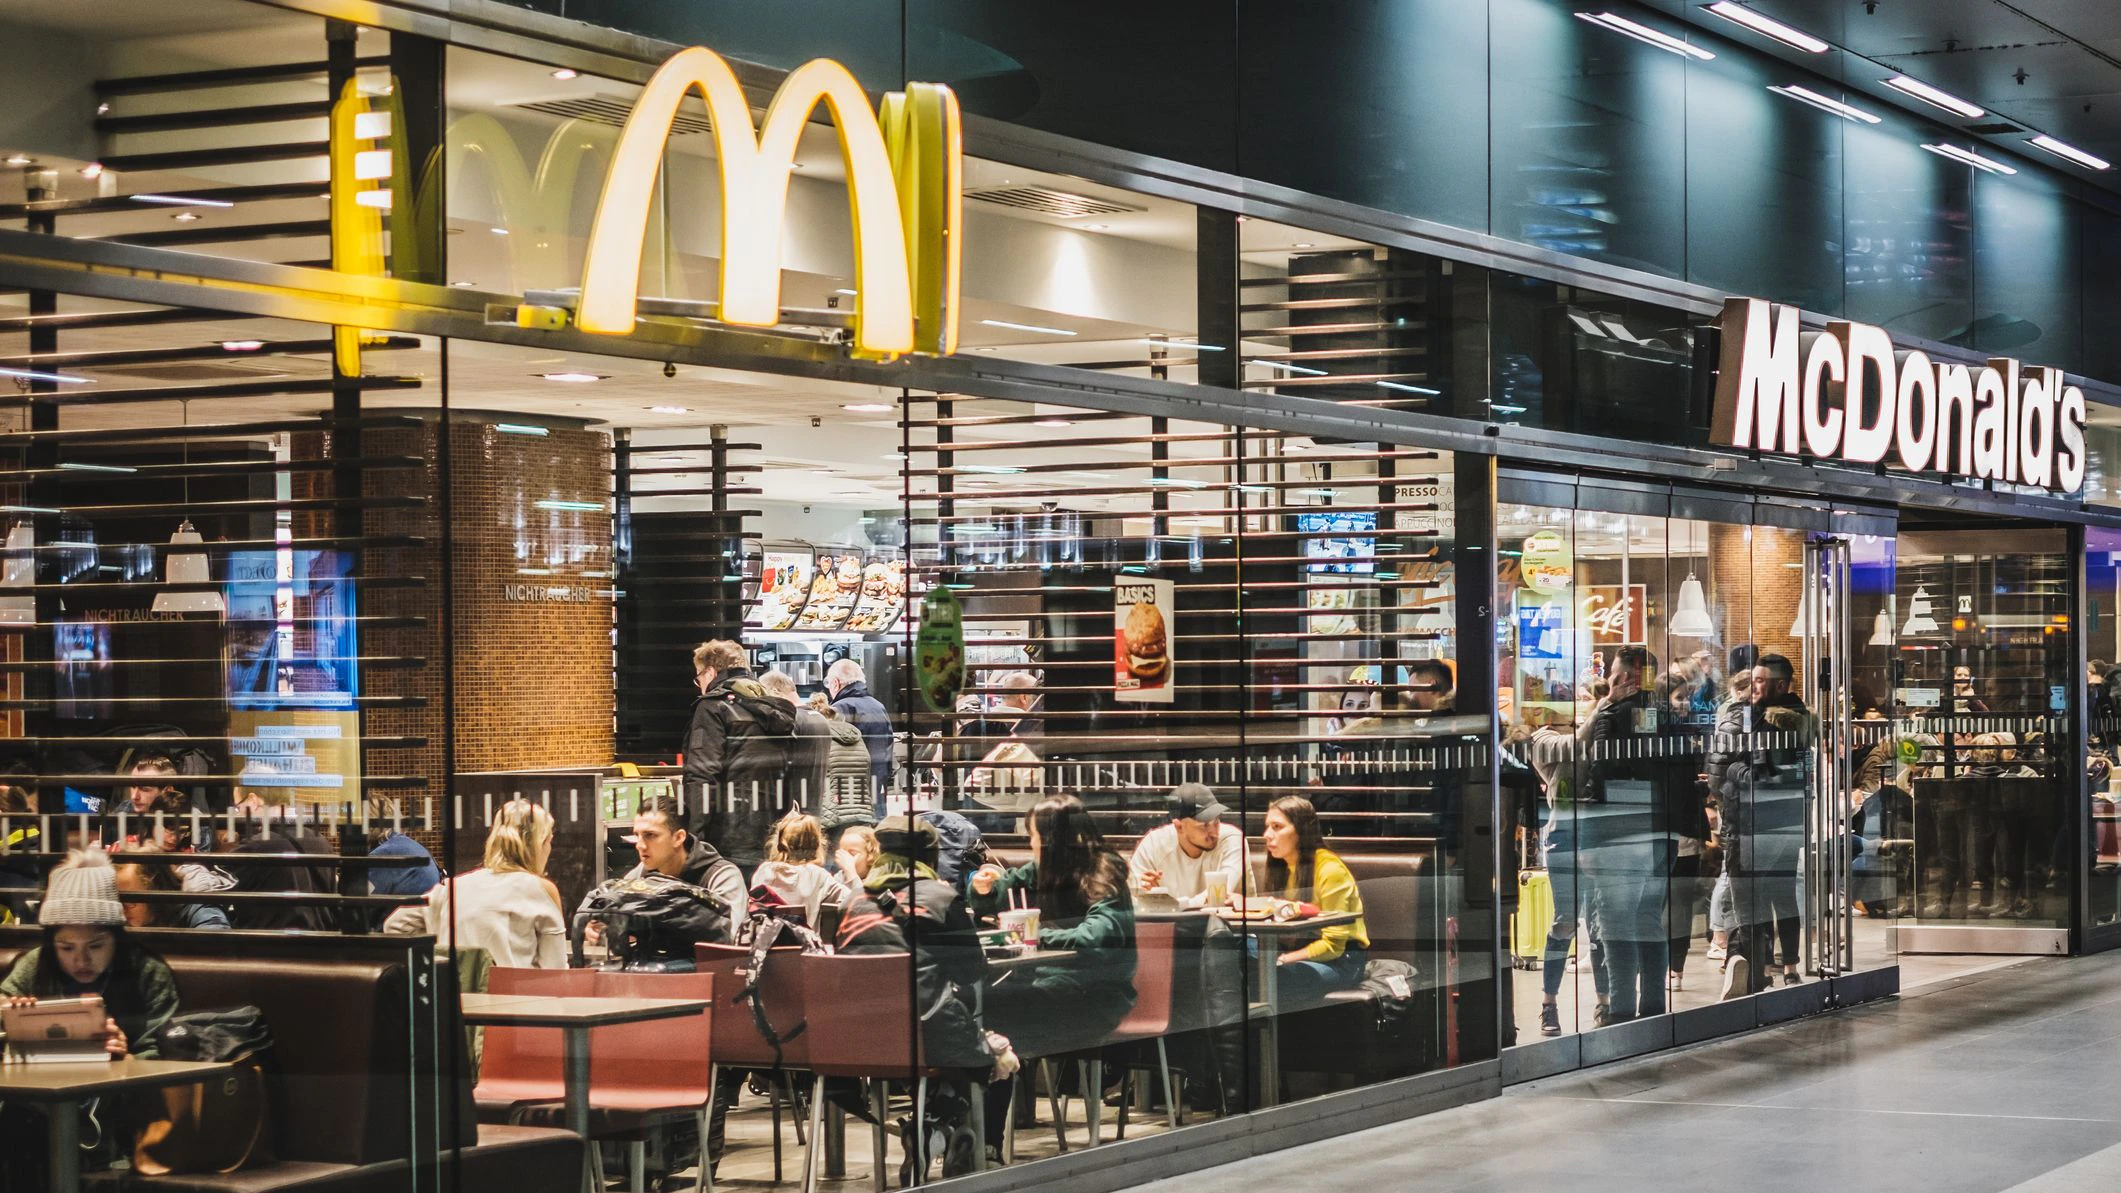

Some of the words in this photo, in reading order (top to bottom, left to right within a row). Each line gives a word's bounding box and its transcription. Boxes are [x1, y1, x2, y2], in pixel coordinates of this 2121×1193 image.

[1731, 297, 2087, 494] McDonald's
[505, 585, 591, 601] NICHTRAUCHER
[1117, 586, 1155, 605] BASICS
[84, 608, 185, 622] NICHTRAUCHER
